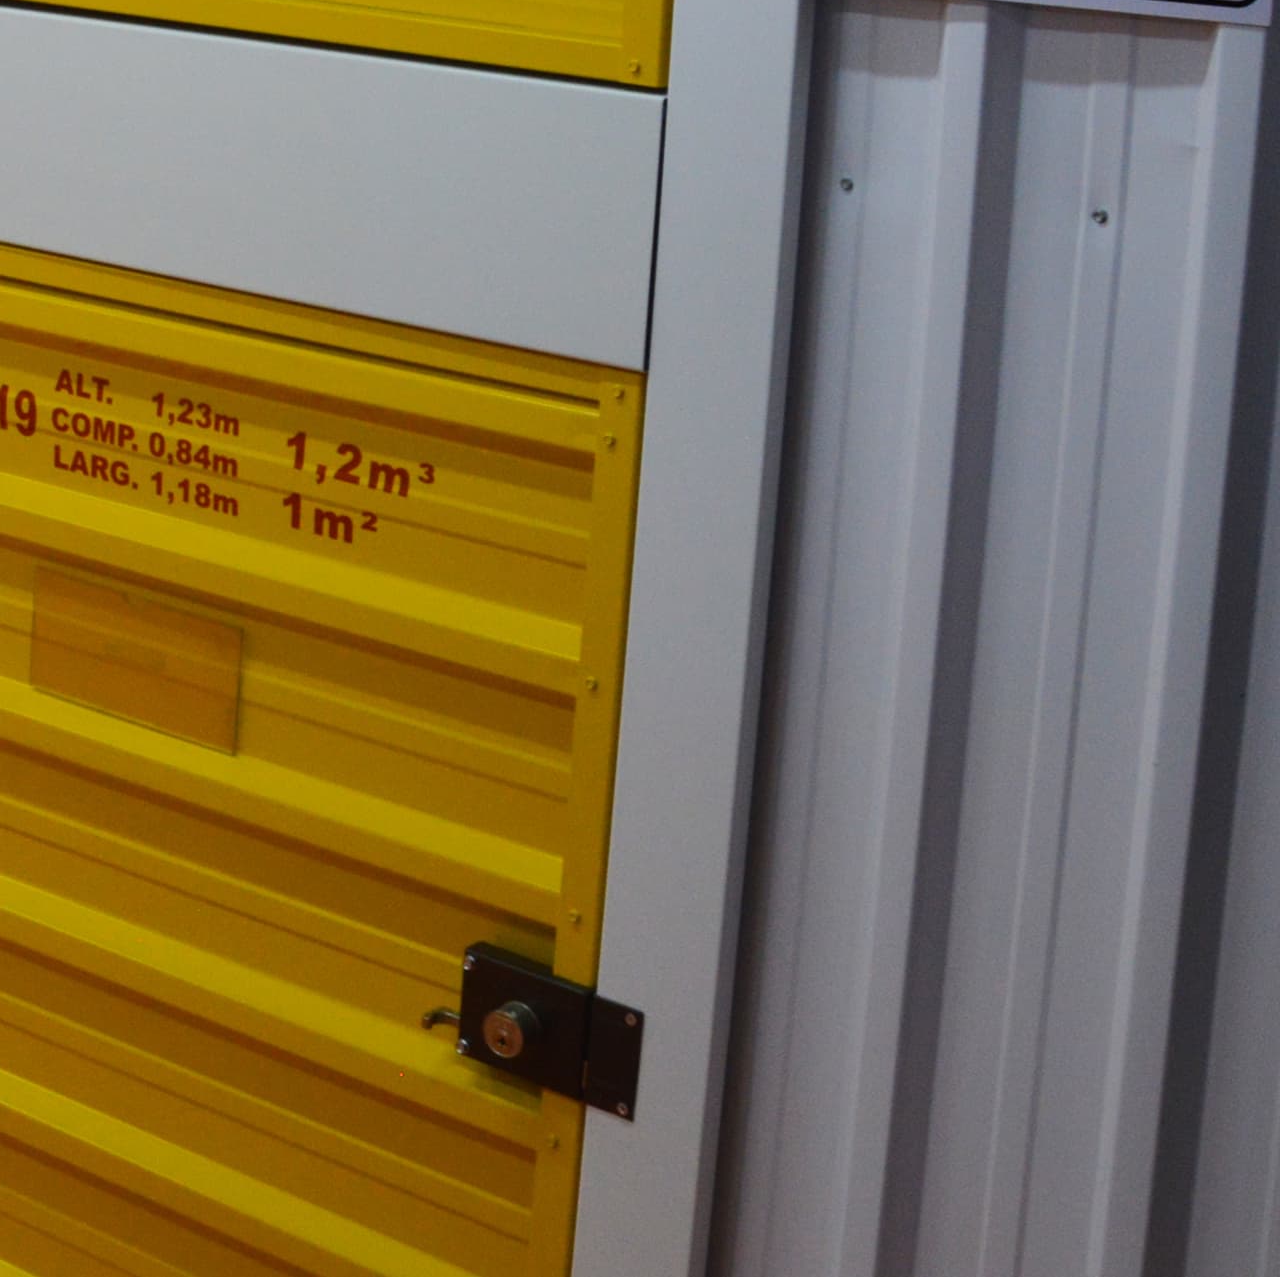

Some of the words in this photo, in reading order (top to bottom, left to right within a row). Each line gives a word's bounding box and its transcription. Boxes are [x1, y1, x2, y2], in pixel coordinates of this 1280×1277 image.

[55, 369, 113, 405] ALT.
[152, 393, 240, 436] 1,23m
[51, 408, 138, 453] COMP.
[149, 431, 239, 477] 0,84m
[286, 430, 435, 497] 1,2m³
[53, 445, 139, 489] LARG.
[150, 470, 239, 517] 1,18m
[282, 492, 378, 544] 1m²
